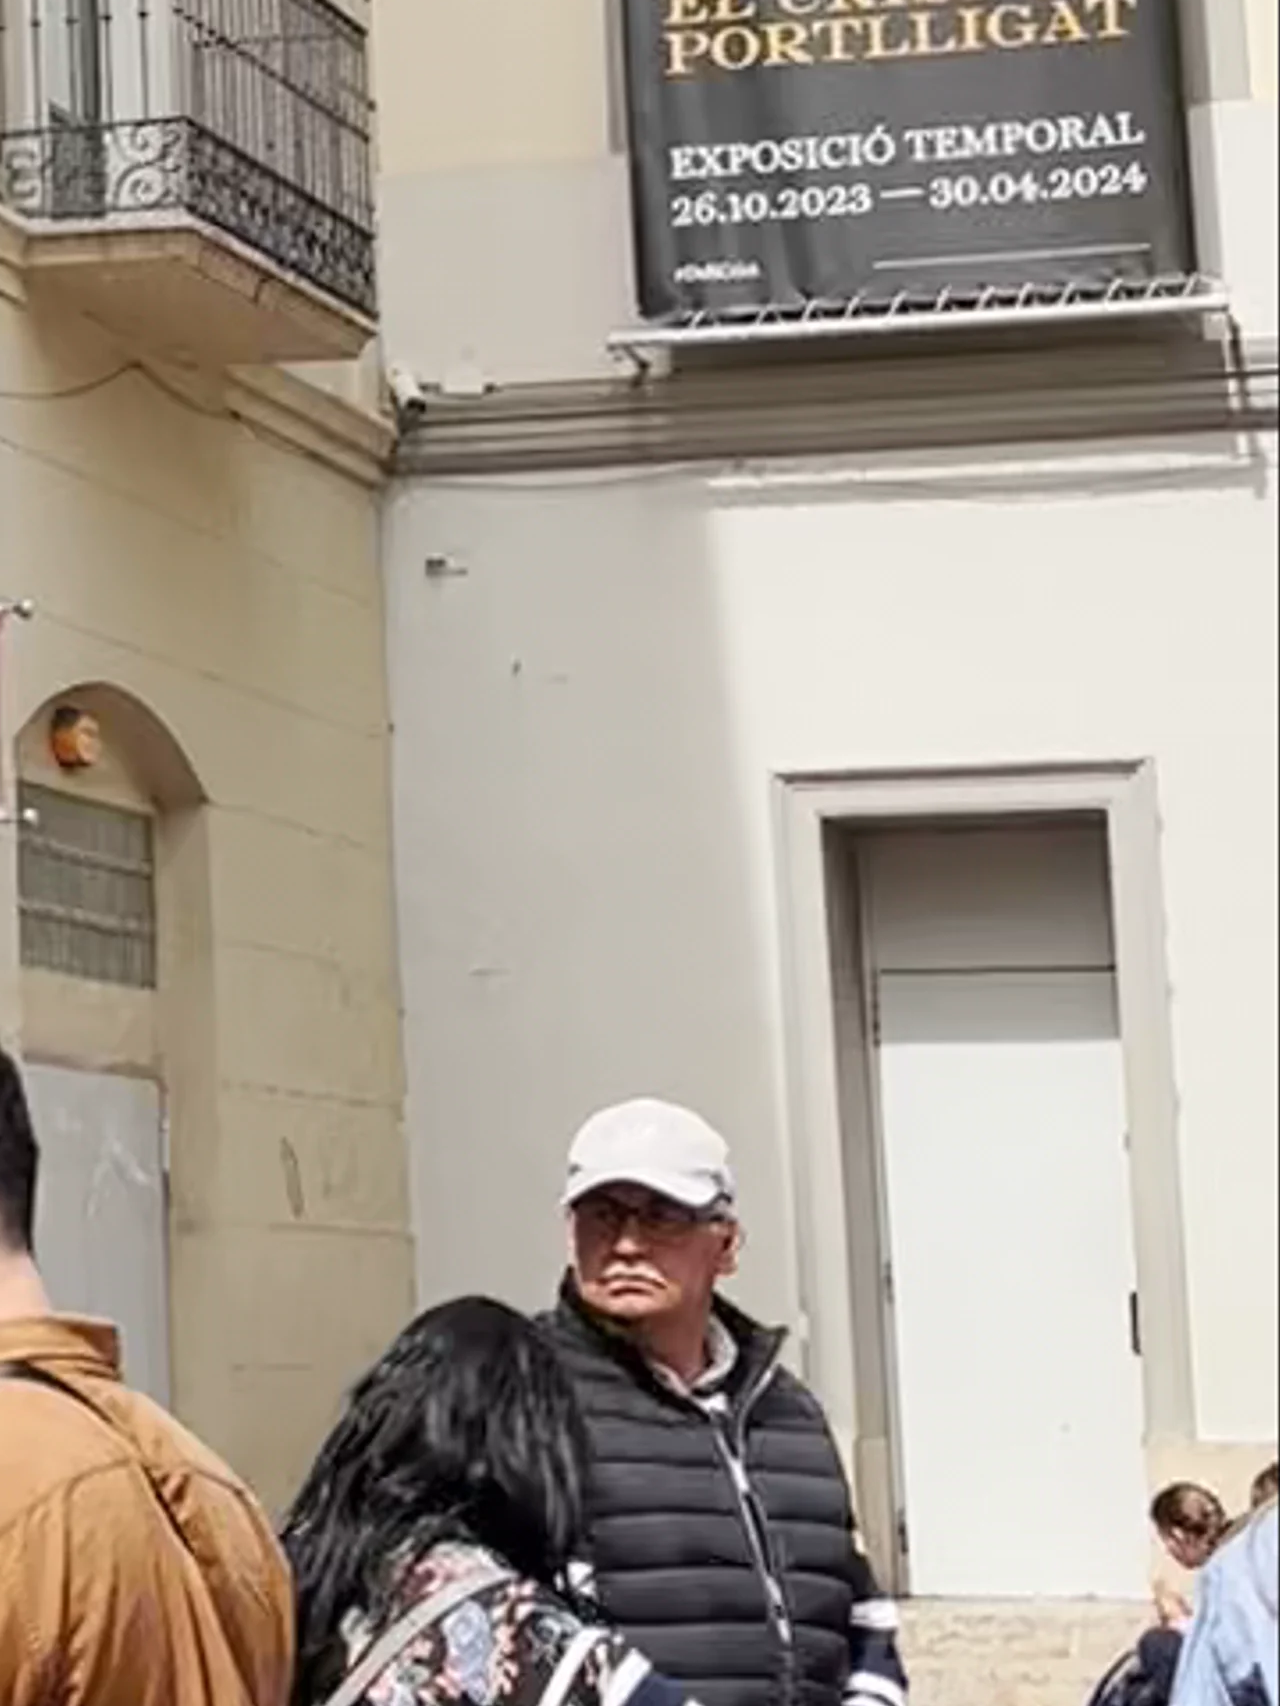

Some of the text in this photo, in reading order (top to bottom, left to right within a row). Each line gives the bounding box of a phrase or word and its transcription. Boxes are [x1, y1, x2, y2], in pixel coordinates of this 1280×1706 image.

[670, 111, 1146, 180] EXPOSICIÓ TEMPORAL
[671, 182, 873, 227] 26.10.2023
[929, 161, 1148, 209] 30.04.2024
